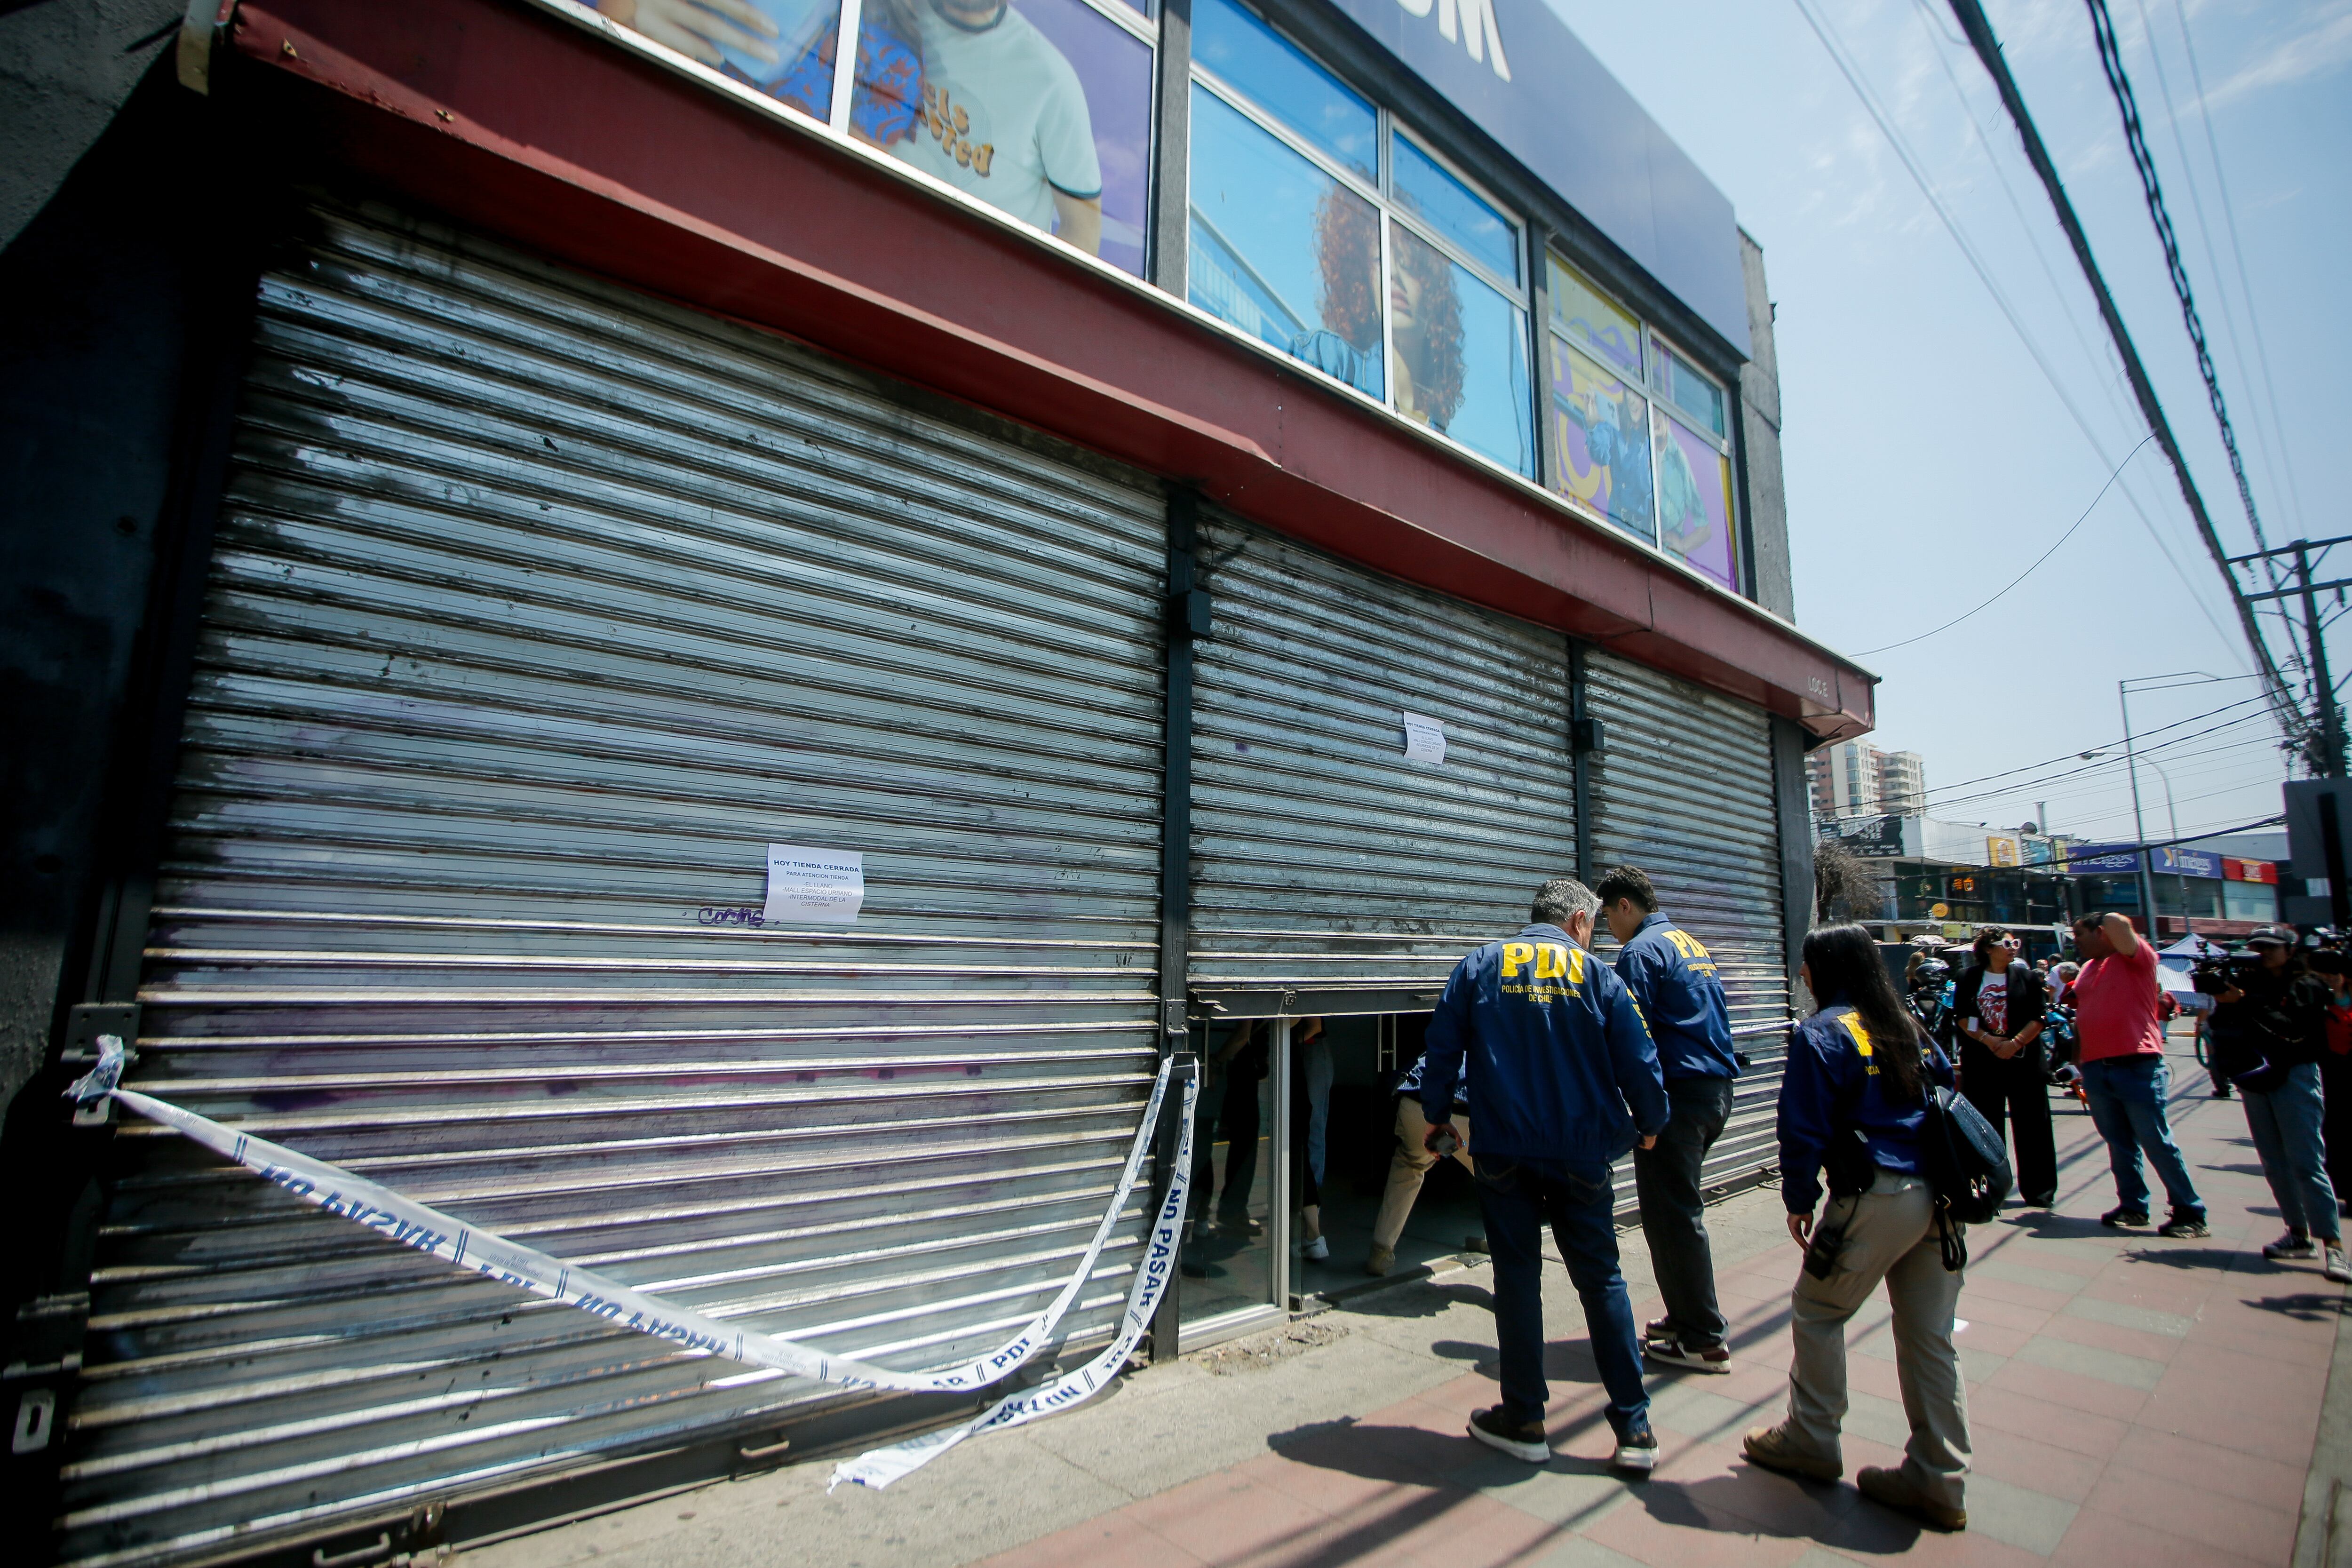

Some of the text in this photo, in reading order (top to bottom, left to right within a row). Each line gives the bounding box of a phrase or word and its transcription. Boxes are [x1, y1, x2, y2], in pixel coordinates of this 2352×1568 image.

[1501, 942, 1586, 984] PDI
[1502, 984, 1524, 994] POLICÍA
[1533, 986, 1581, 998] INVESTIGACIONES
[1139, 1189, 1181, 1306] NO PASAR
